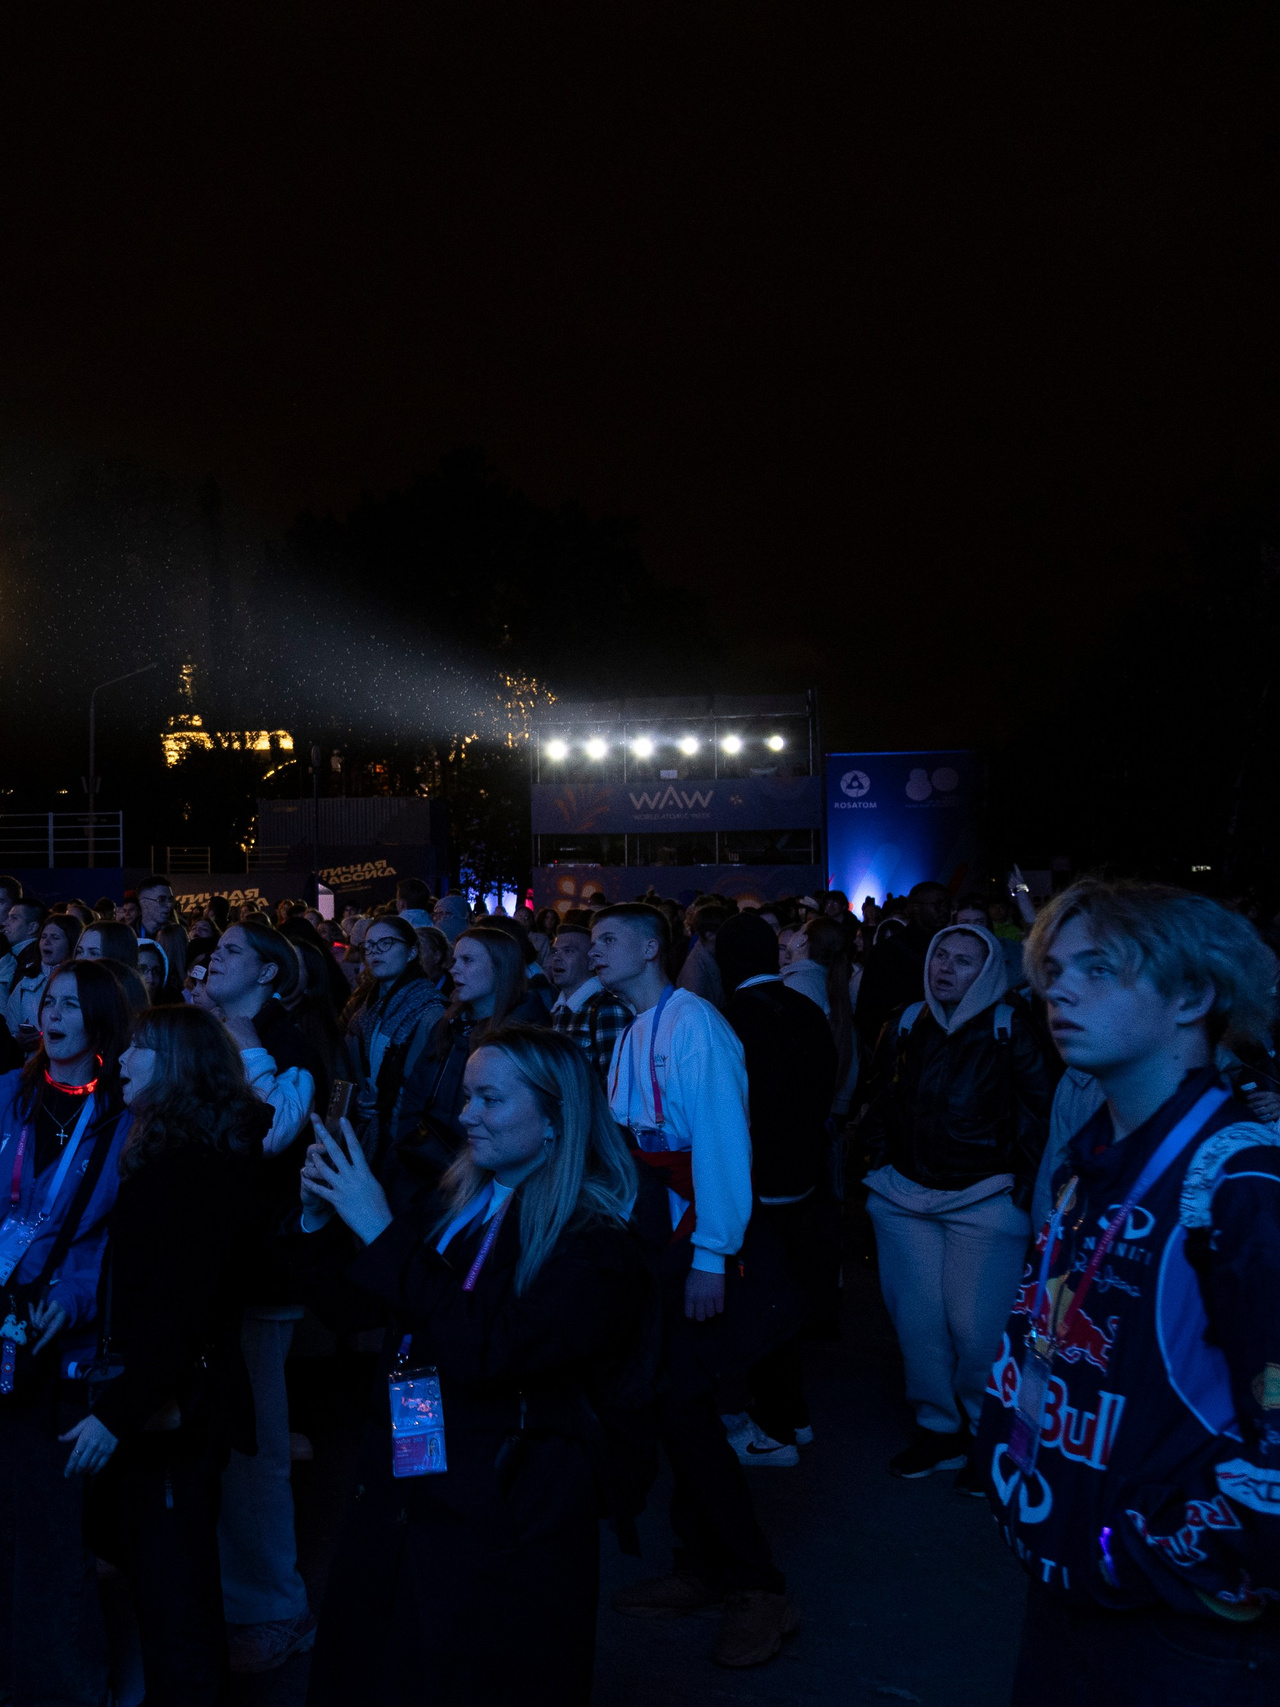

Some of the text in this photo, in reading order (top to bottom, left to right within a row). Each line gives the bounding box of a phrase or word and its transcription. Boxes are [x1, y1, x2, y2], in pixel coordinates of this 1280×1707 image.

[629, 785, 714, 809] WAW
[833, 801, 878, 810] ROSATOM
[323, 867, 397, 885] АССИКА
